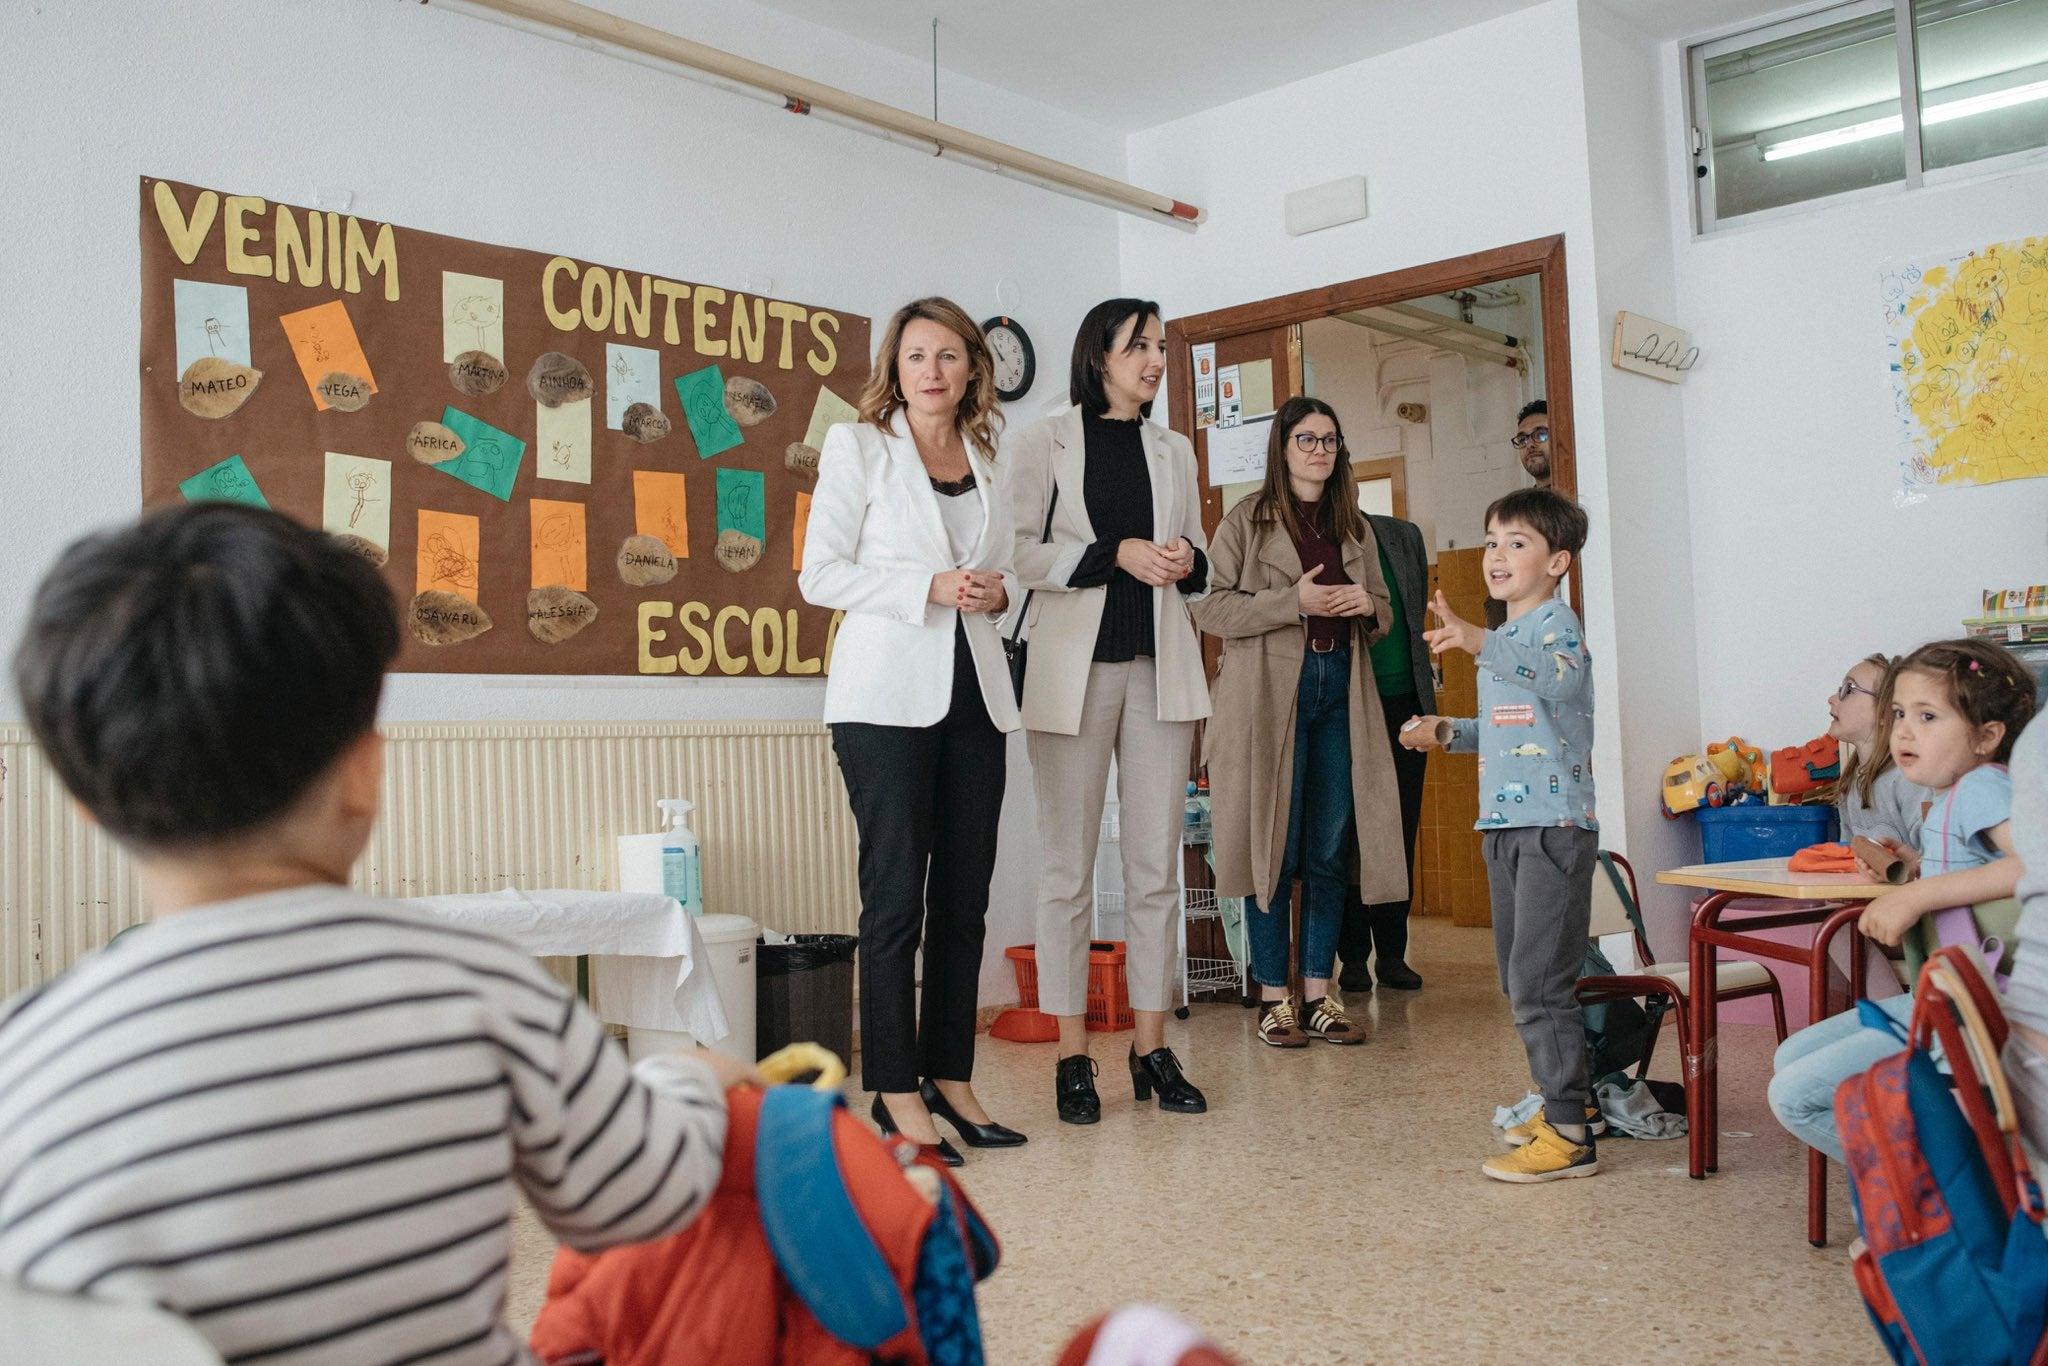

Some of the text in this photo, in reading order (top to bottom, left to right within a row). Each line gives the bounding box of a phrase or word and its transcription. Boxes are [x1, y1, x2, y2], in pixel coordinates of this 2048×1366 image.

[154, 181, 400, 302] VENIM
[542, 256, 840, 376] CONTENTS
[458, 363, 505, 382] MARTINA
[190, 374, 248, 397] MATEO
[324, 383, 361, 399] VEGA
[539, 375, 584, 390] AINHOA
[731, 391, 767, 410] ISMAEL
[629, 415, 668, 430] MARCOS
[414, 431, 458, 451] ÁFRICA
[625, 552, 674, 570] DANIELA
[416, 608, 478, 626] OSAWARU
[537, 604, 587, 619] ALESSIA
